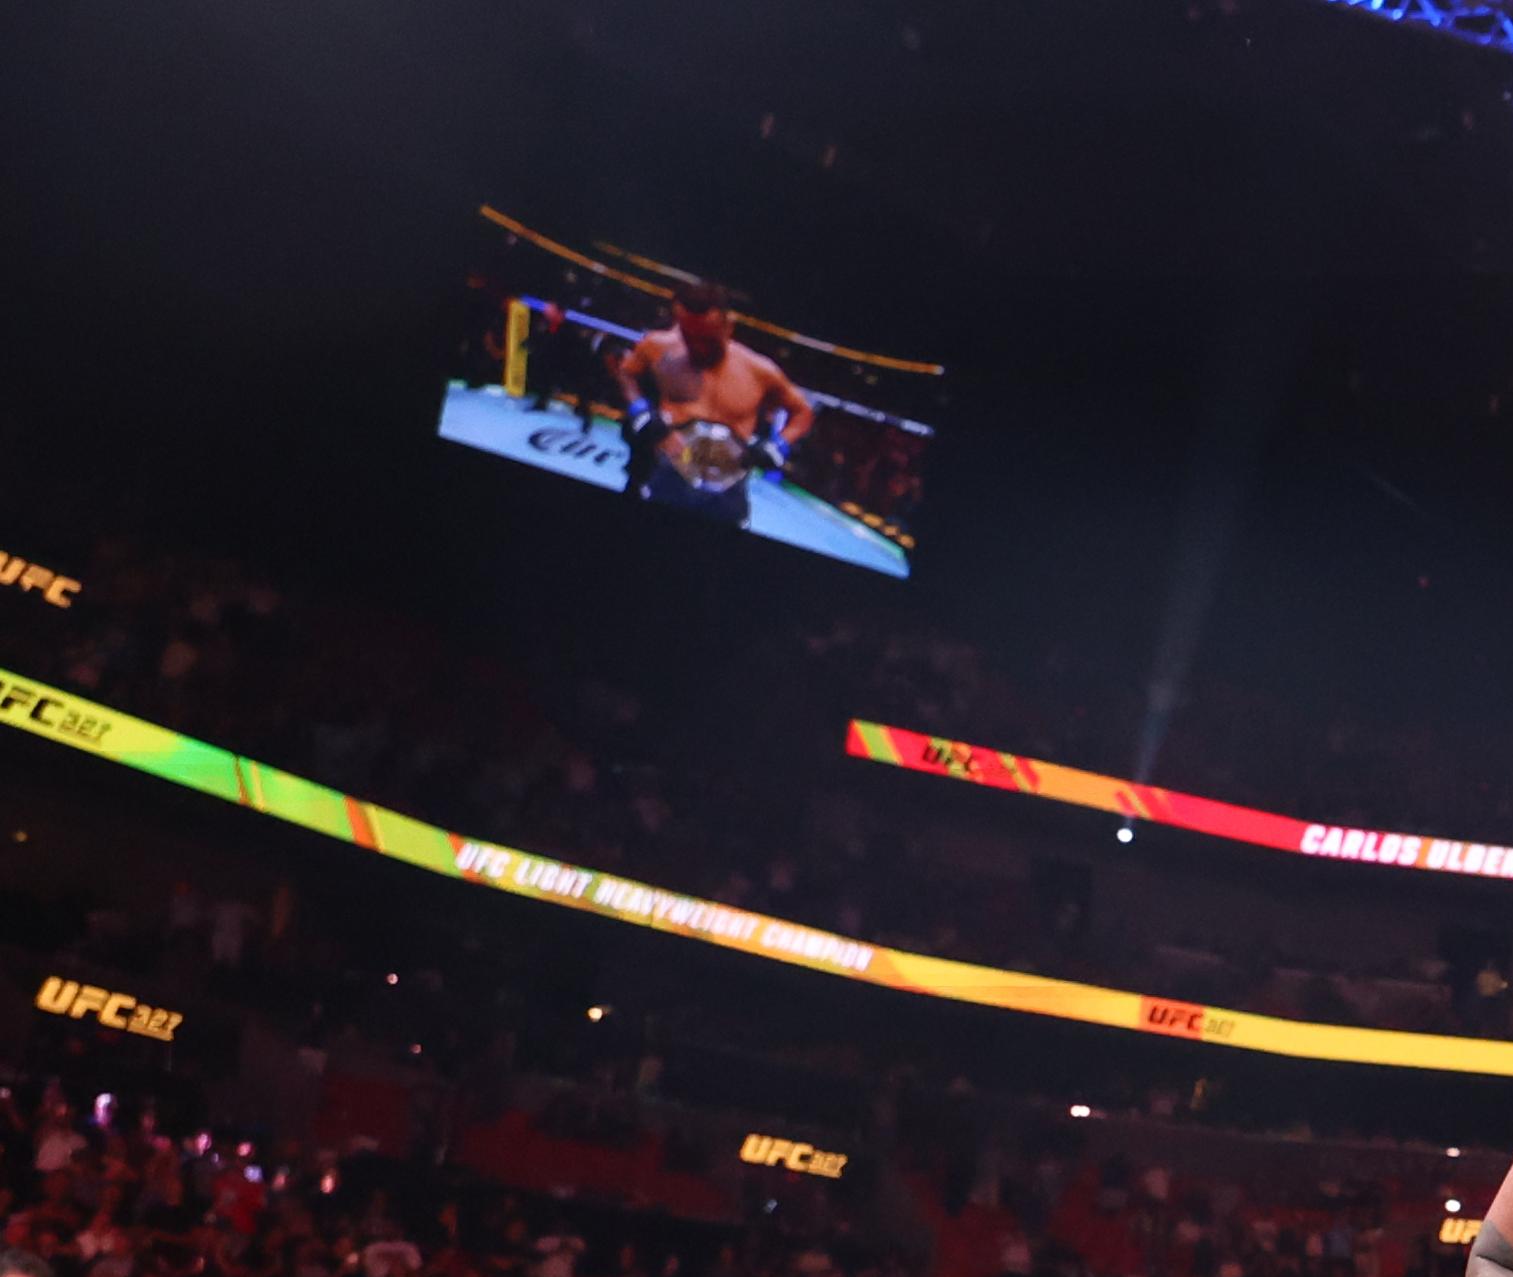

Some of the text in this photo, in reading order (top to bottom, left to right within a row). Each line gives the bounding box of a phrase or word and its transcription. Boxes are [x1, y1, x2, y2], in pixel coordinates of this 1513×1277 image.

[0, 679, 65, 727] FC
[1300, 824, 1422, 867] CARLOS
[454, 841, 510, 878] UFC
[513, 856, 593, 899] LIGHT
[759, 921, 874, 972] CHAMPION
[36, 976, 137, 1029] UFC
[1148, 1005, 1203, 1032] UFC
[739, 1132, 813, 1172] UFC
